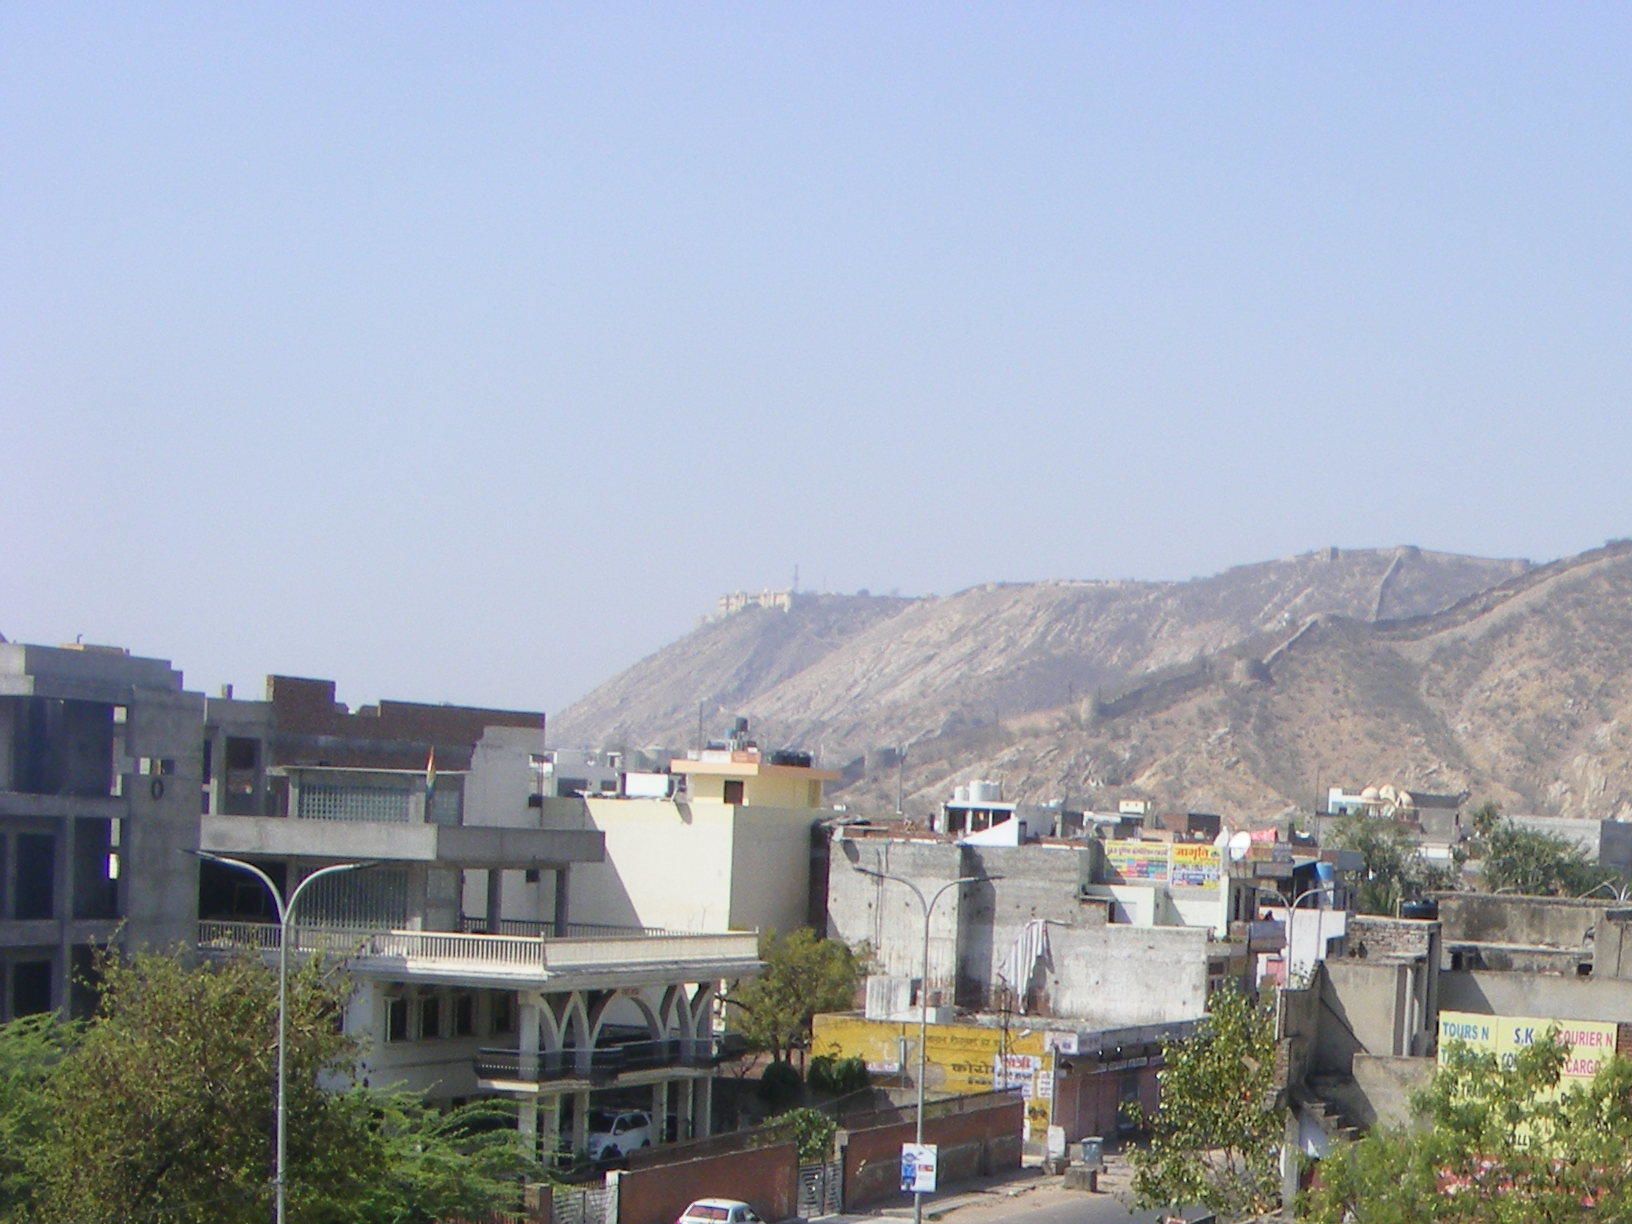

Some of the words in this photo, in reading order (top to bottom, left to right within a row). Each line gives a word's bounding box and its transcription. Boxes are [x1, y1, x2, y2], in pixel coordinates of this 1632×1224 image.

[1442, 1021, 1478, 1040] TOURS
[1481, 1026, 1490, 1040] N
[1556, 1030, 1602, 1047] COURIER
[1605, 1032, 1614, 1047] N
